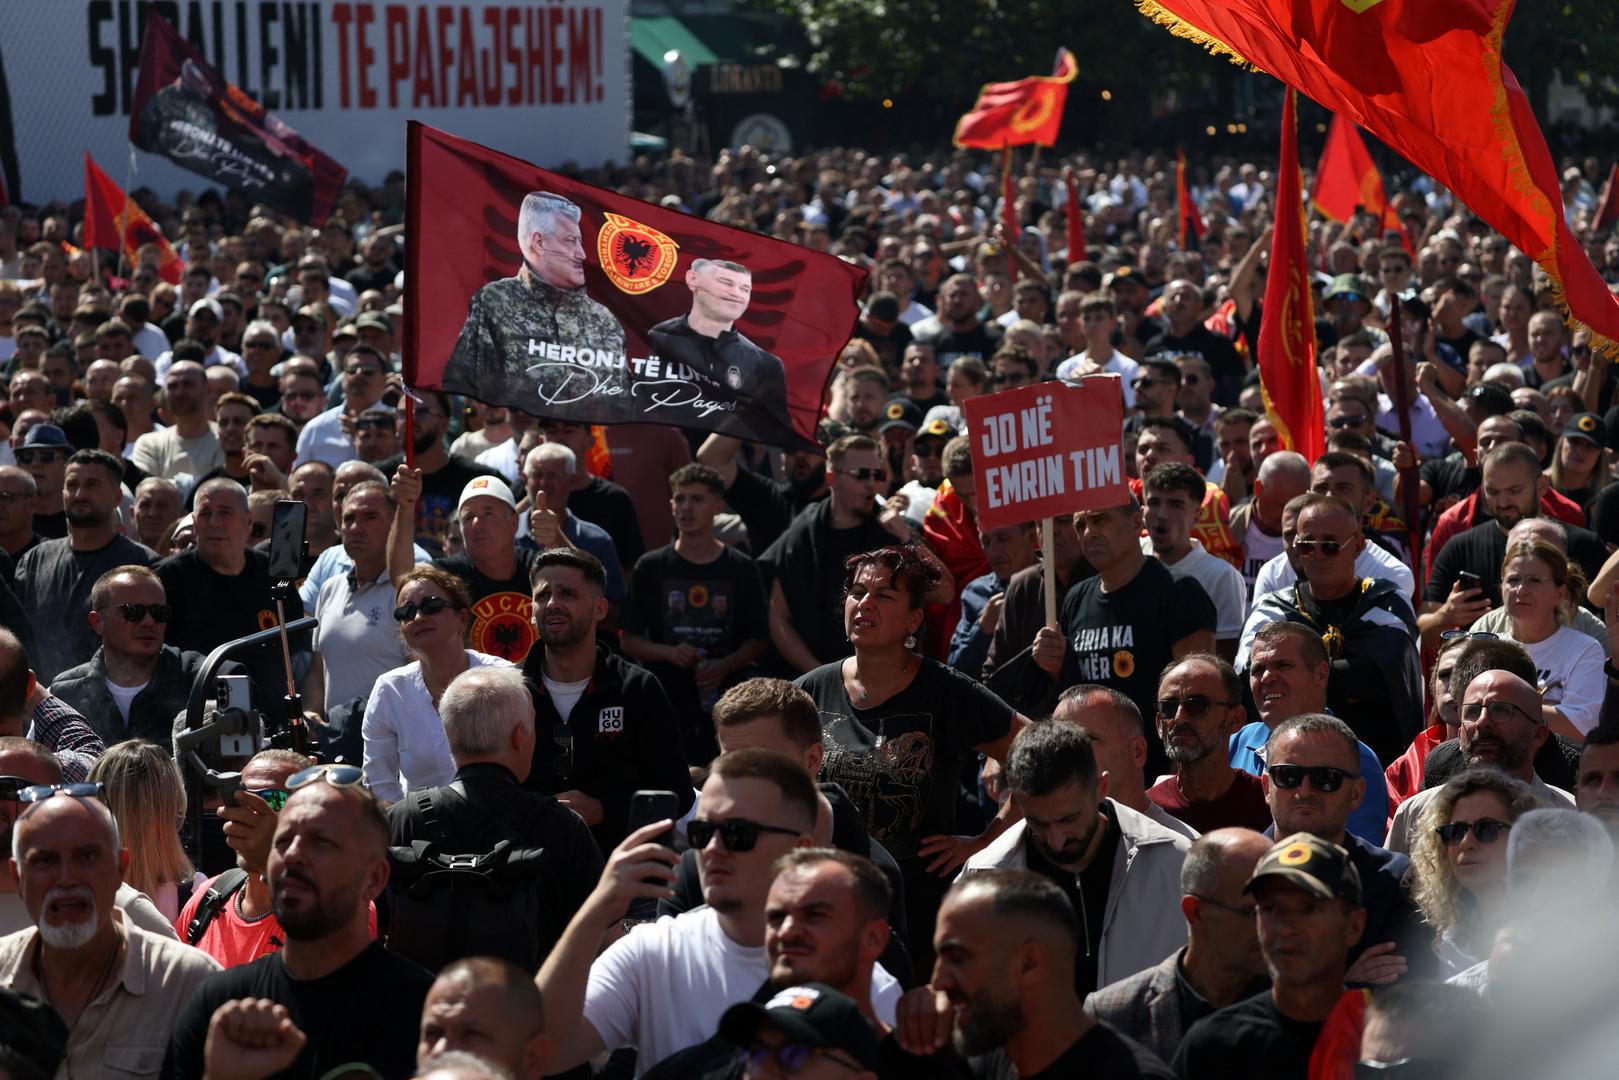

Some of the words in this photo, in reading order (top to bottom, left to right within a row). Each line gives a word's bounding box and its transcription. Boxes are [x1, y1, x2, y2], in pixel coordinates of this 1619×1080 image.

[981, 412, 1017, 457] JO
[1021, 395, 1055, 449] NË
[985, 453, 1065, 509] EMRIN
[1070, 444, 1121, 492] TIM
[477, 595, 531, 618] UÇK
[1112, 624, 1134, 648] KA
[602, 710, 620, 719] HU
[602, 719, 621, 728] GO
